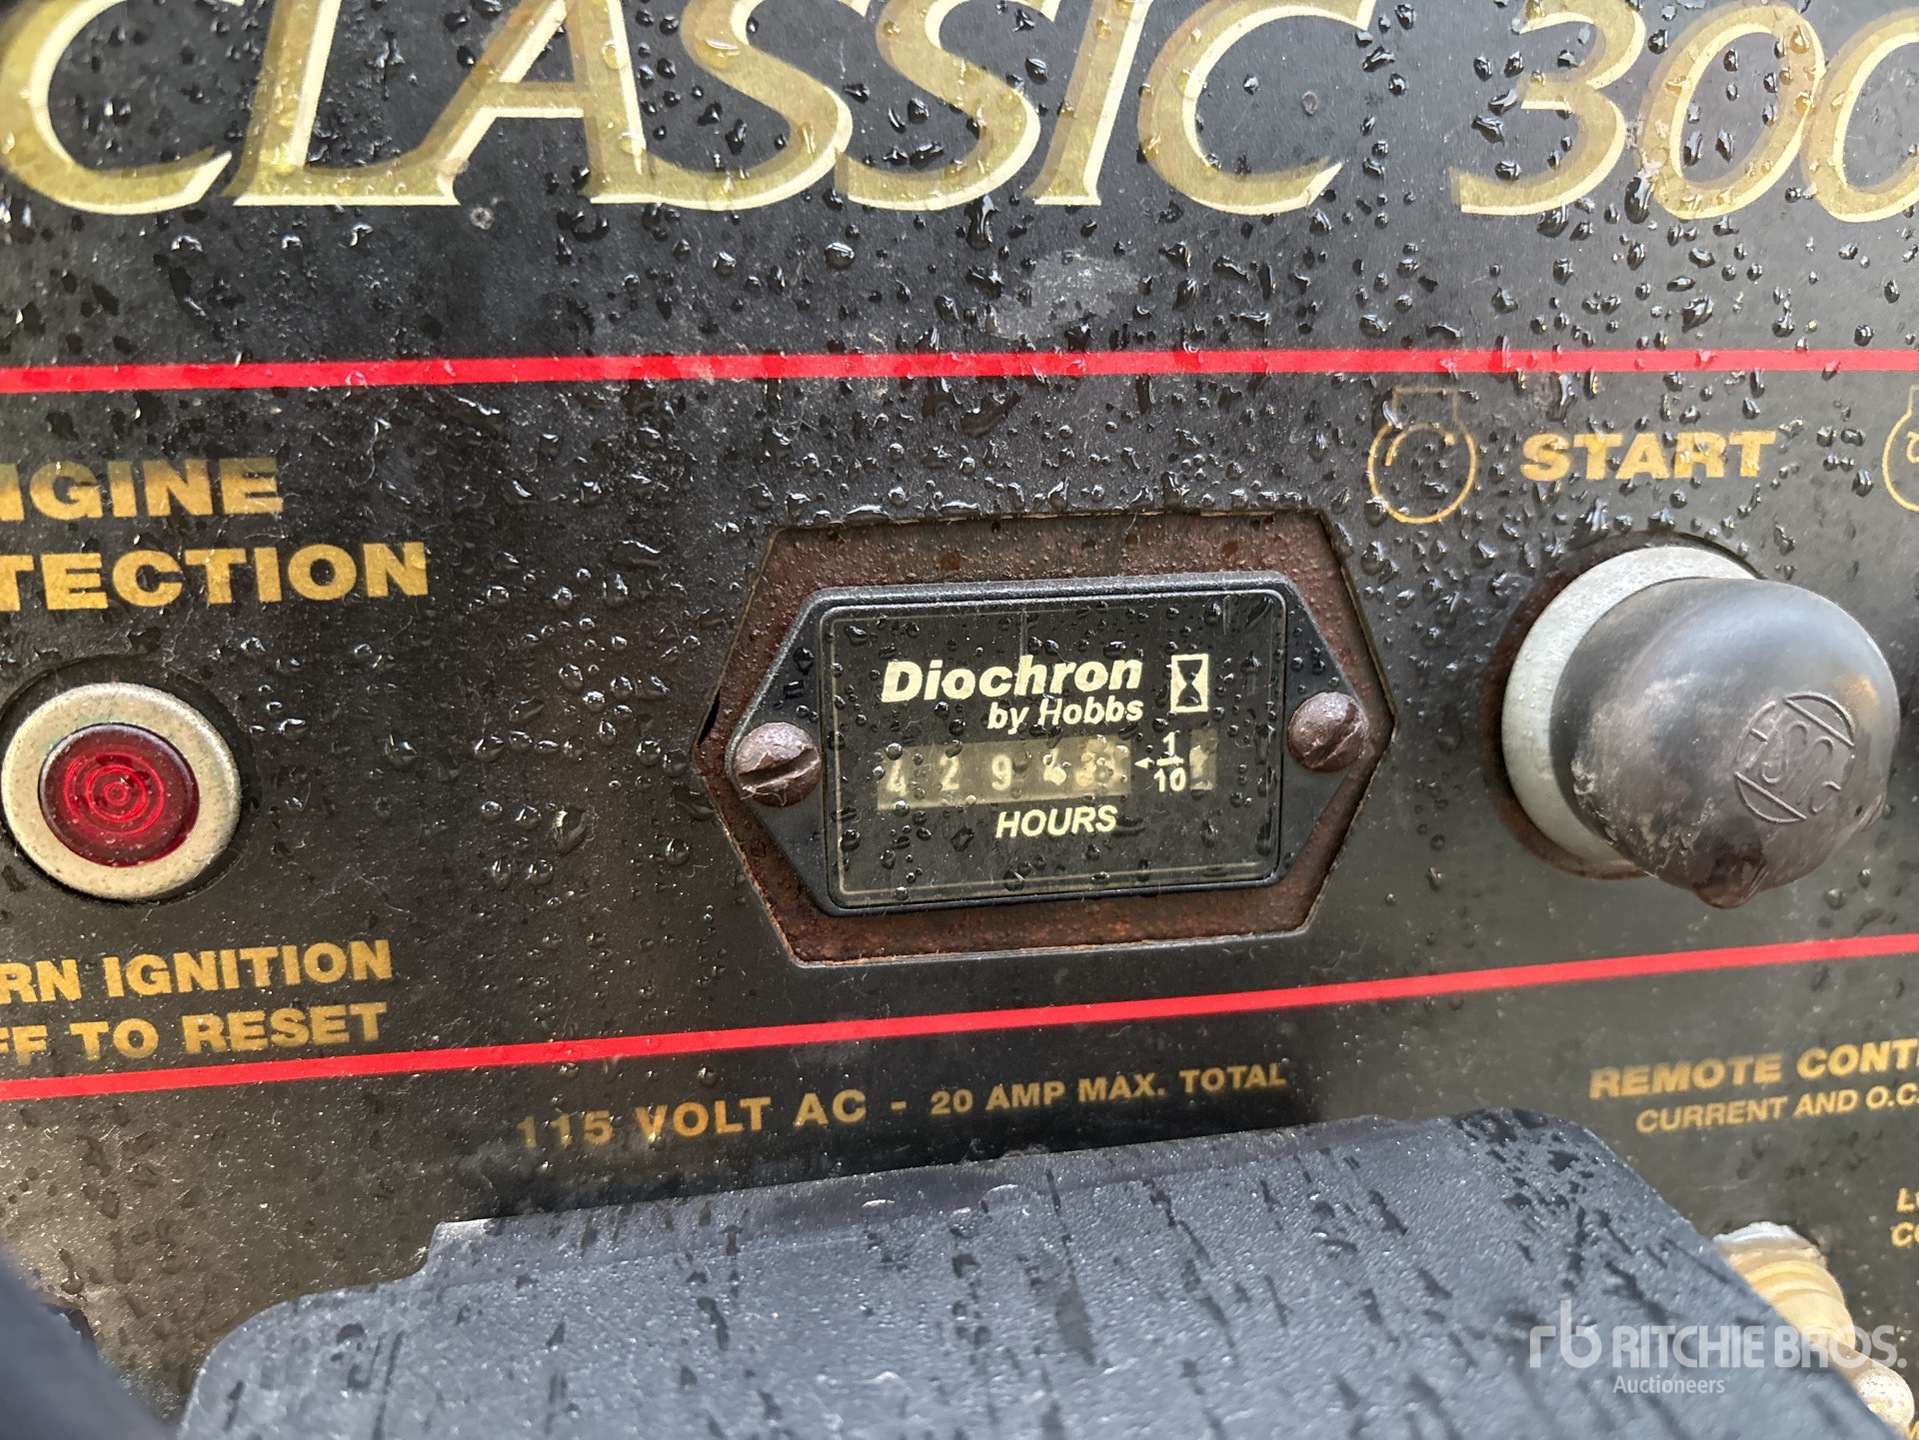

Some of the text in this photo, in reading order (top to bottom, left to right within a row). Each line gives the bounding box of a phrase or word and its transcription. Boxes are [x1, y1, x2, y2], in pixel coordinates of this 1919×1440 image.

[0, 0, 1372, 214] CLASSIC
[1520, 430, 1776, 481] START
[880, 654, 1143, 703] Diochron
[987, 696, 1144, 735] by Hobbs
[996, 804, 1118, 838] HOURS
[103, 940, 393, 997] IGNITION
[69, 1020, 159, 1061] TO
[181, 1002, 388, 1055] RESET
[1589, 1038, 1919, 1100] REMOTE CONT
[517, 1110, 614, 1150] 115
[635, 1096, 771, 1144] VOLT
[793, 1089, 866, 1127] AC
[930, 1088, 973, 1116] 20
[986, 1081, 1065, 1110] AMP
[1079, 1072, 1166, 1103] MAX.
[1180, 1063, 1287, 1095] TOTAL
[1636, 1095, 1788, 1134] CURRENT
[1793, 1088, 1859, 1119] AND
[1895, 1187, 1919, 1213] L
[1890, 1221, 1919, 1248] C
